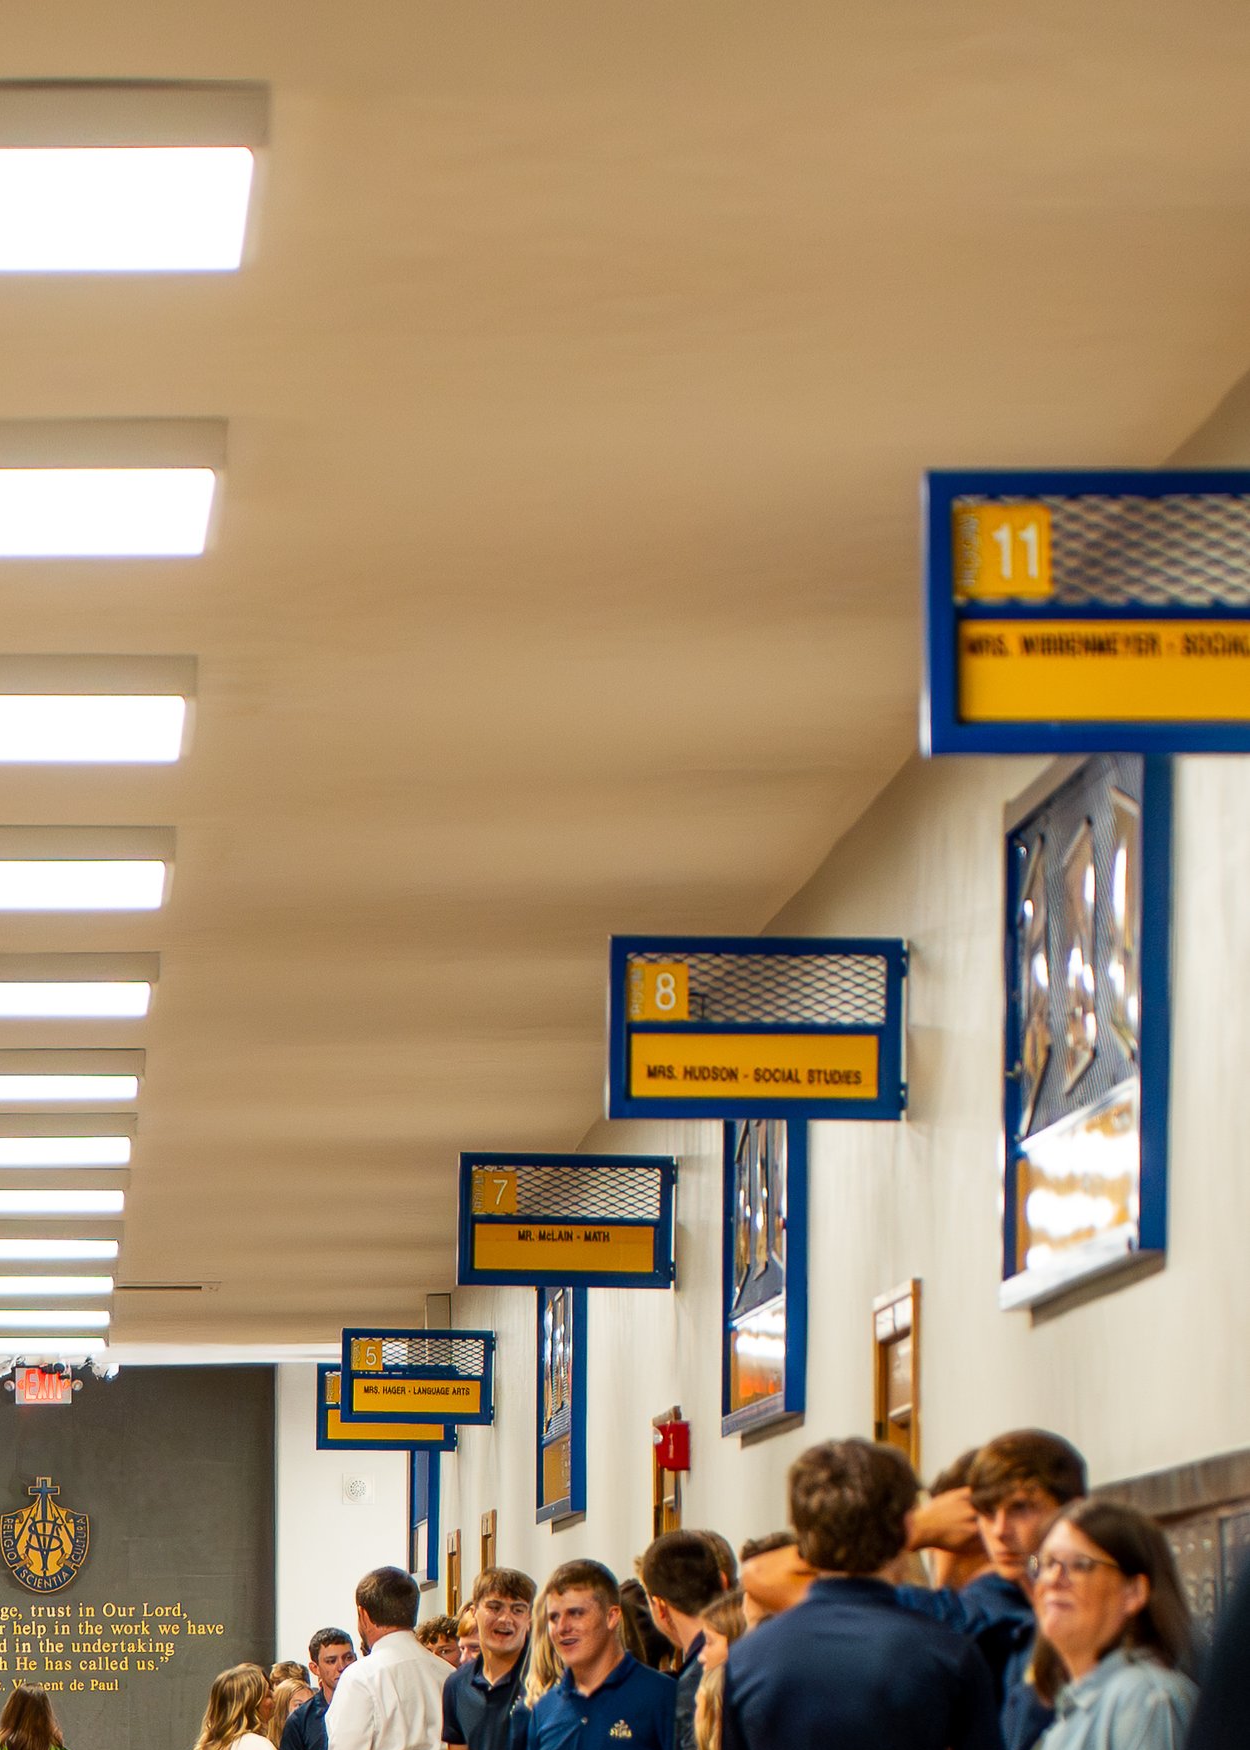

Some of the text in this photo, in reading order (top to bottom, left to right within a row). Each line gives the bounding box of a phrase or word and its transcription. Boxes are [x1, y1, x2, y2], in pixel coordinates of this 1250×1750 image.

[992, 523, 1039, 579] 11
[655, 972, 676, 1011] 8
[647, 1065, 677, 1081] MRS.
[683, 1066, 738, 1082] HUDSON
[753, 1068, 801, 1083] SOCIAL
[807, 1069, 862, 1084] STUDIES
[493, 1179, 508, 1205] 7
[518, 1231, 535, 1242] MR.
[539, 1231, 573, 1242] McLAIN
[584, 1231, 610, 1242] MATH
[365, 1346, 377, 1366] 5
[25, 1369, 62, 1400] EXIT
[363, 1386, 380, 1395] MRS.
[383, 1386, 406, 1395] HAGER
[413, 1387, 450, 1396] LANGUAGE
[452, 1387, 470, 1396] ARTS
[3, 1517, 17, 1561] RELIGIO
[71, 1516, 86, 1562] CULTURA
[20, 1569, 69, 1588] SCIENTIA
[31, 1604, 72, 1618] trust
[79, 1603, 95, 1617] in
[102, 1603, 135, 1618] Our
[143, 1602, 188, 1619] Lord,
[13, 1621, 47, 1638] help
[54, 1621, 70, 1635] in
[78, 1621, 103, 1635] the
[111, 1620, 150, 1635] work
[159, 1624, 180, 1635] we
[187, 1621, 224, 1635] have
[15, 1638, 31, 1653] in
[39, 1639, 64, 1653] the
[71, 1638, 175, 1656] undertaking
[16, 1657, 37, 1671] He
[45, 1657, 72, 1671] has
[79, 1656, 129, 1671] called
[12, 1679, 64, 1691] Vent
[69, 1679, 85, 1691] de
[90, 1679, 119, 1691] Paul
